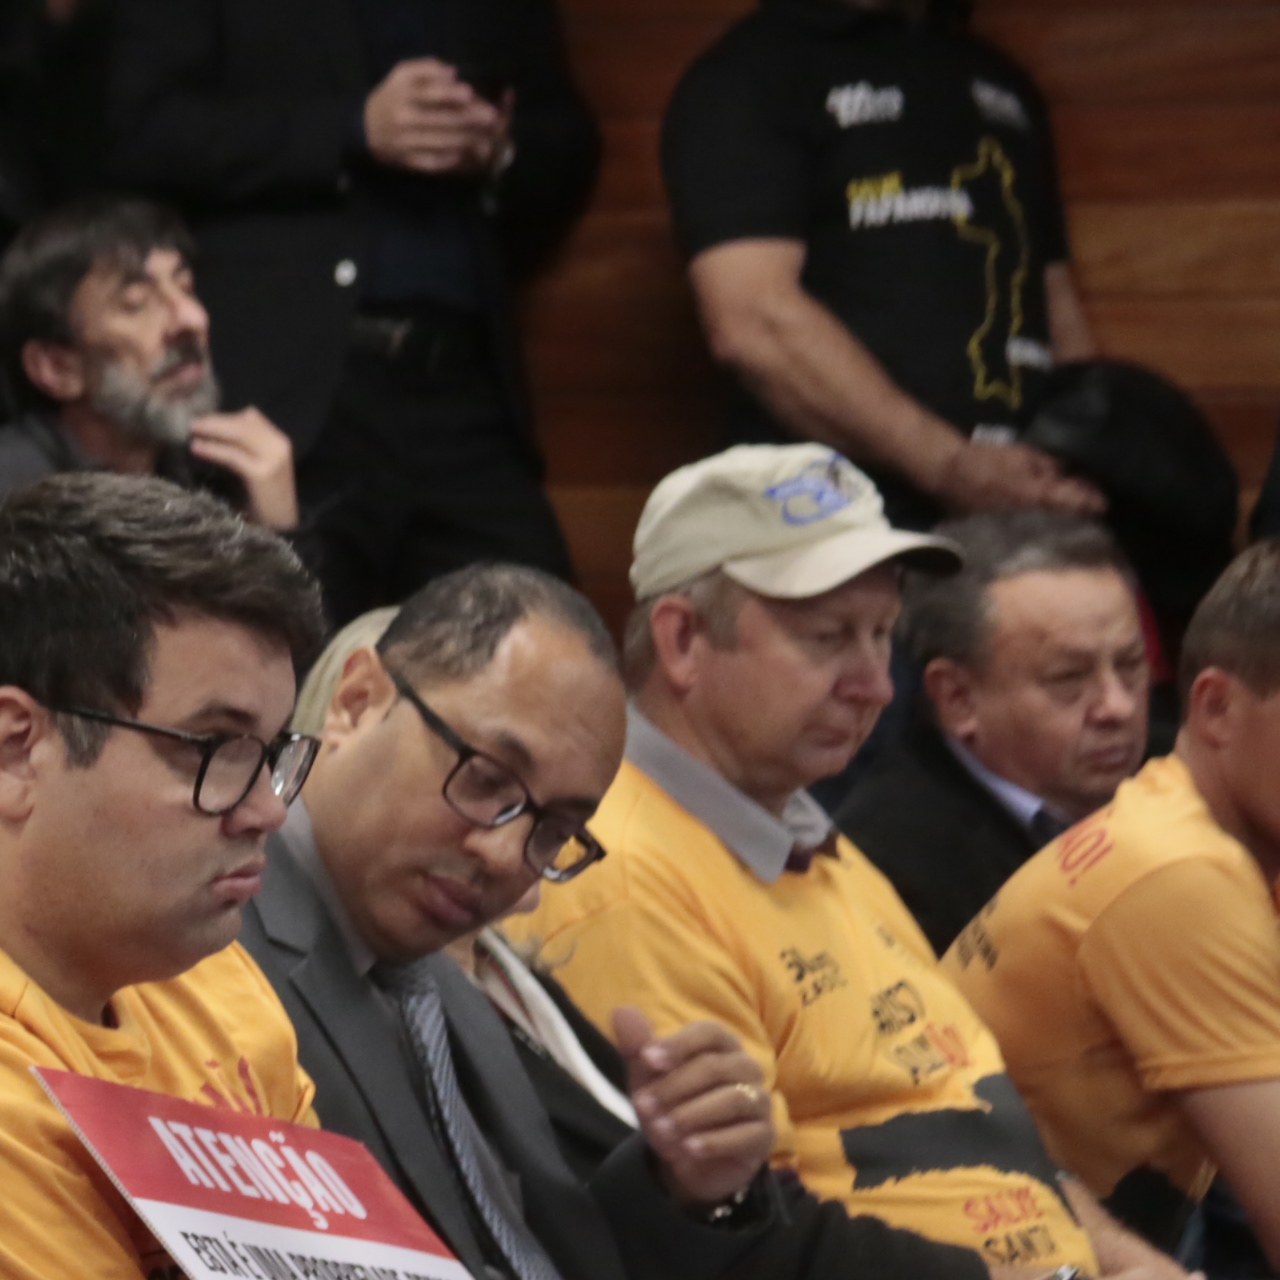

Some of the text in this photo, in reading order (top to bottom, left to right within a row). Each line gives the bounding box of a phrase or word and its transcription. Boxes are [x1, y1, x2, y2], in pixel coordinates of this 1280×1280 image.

[148, 1115, 368, 1230] ATENÇÃO
[179, 1230, 249, 1279] ESTA
[223, 1230, 263, 1280] É
